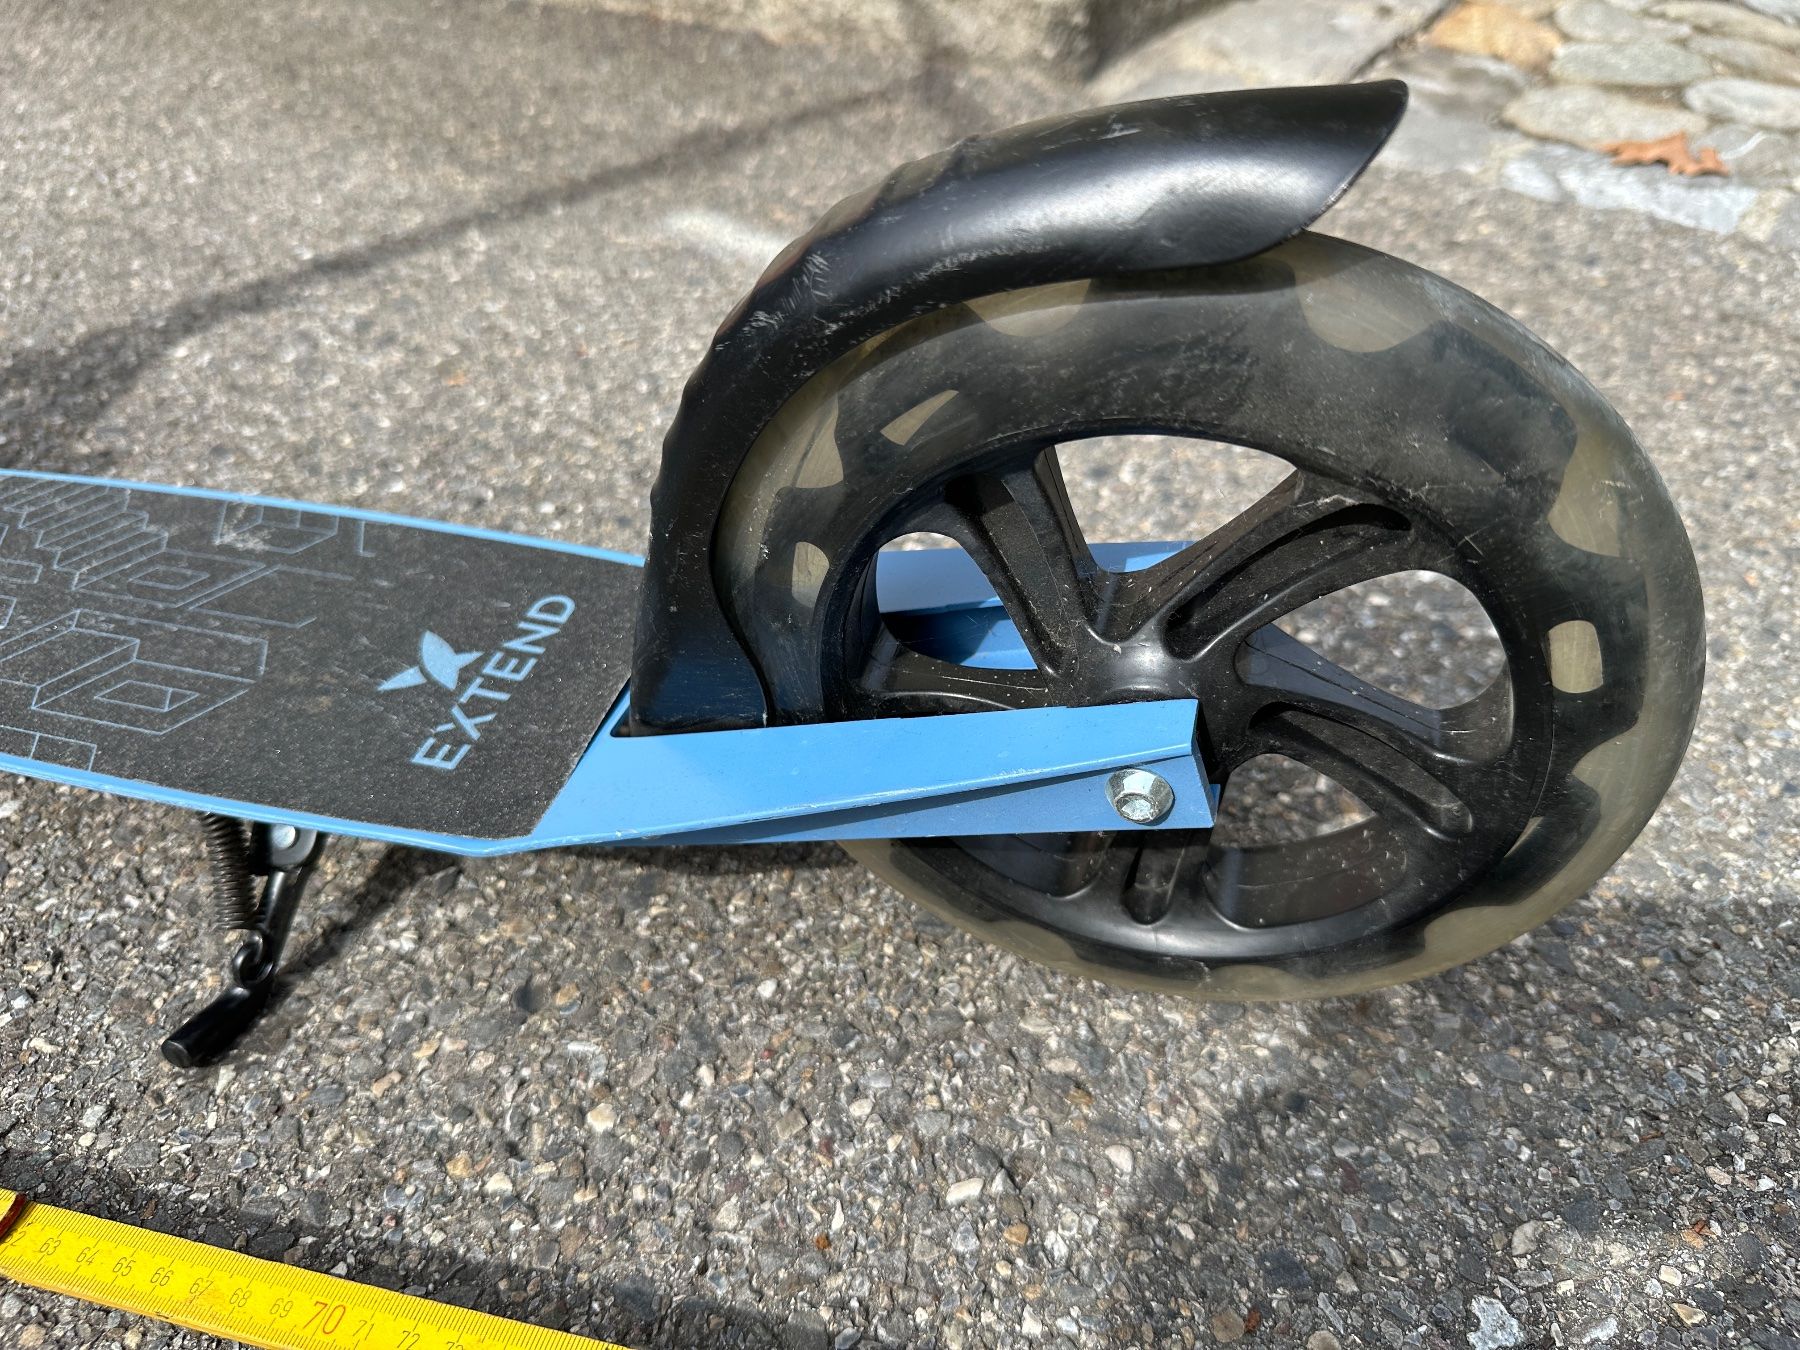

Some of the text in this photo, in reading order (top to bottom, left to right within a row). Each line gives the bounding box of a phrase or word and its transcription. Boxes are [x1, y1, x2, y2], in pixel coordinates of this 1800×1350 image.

[411, 594, 576, 770] EXTEND
[38, 1237, 62, 1256] 63
[76, 1247, 100, 1266] 64
[113, 1256, 137, 1276] 65
[150, 1267, 174, 1287] 66
[189, 1278, 215, 1297] 67
[229, 1288, 253, 1308] 68
[269, 1297, 295, 1318] 69
[302, 1301, 347, 1334] 70
[352, 1320, 376, 1341] 71
[397, 1330, 421, 1350] 72
